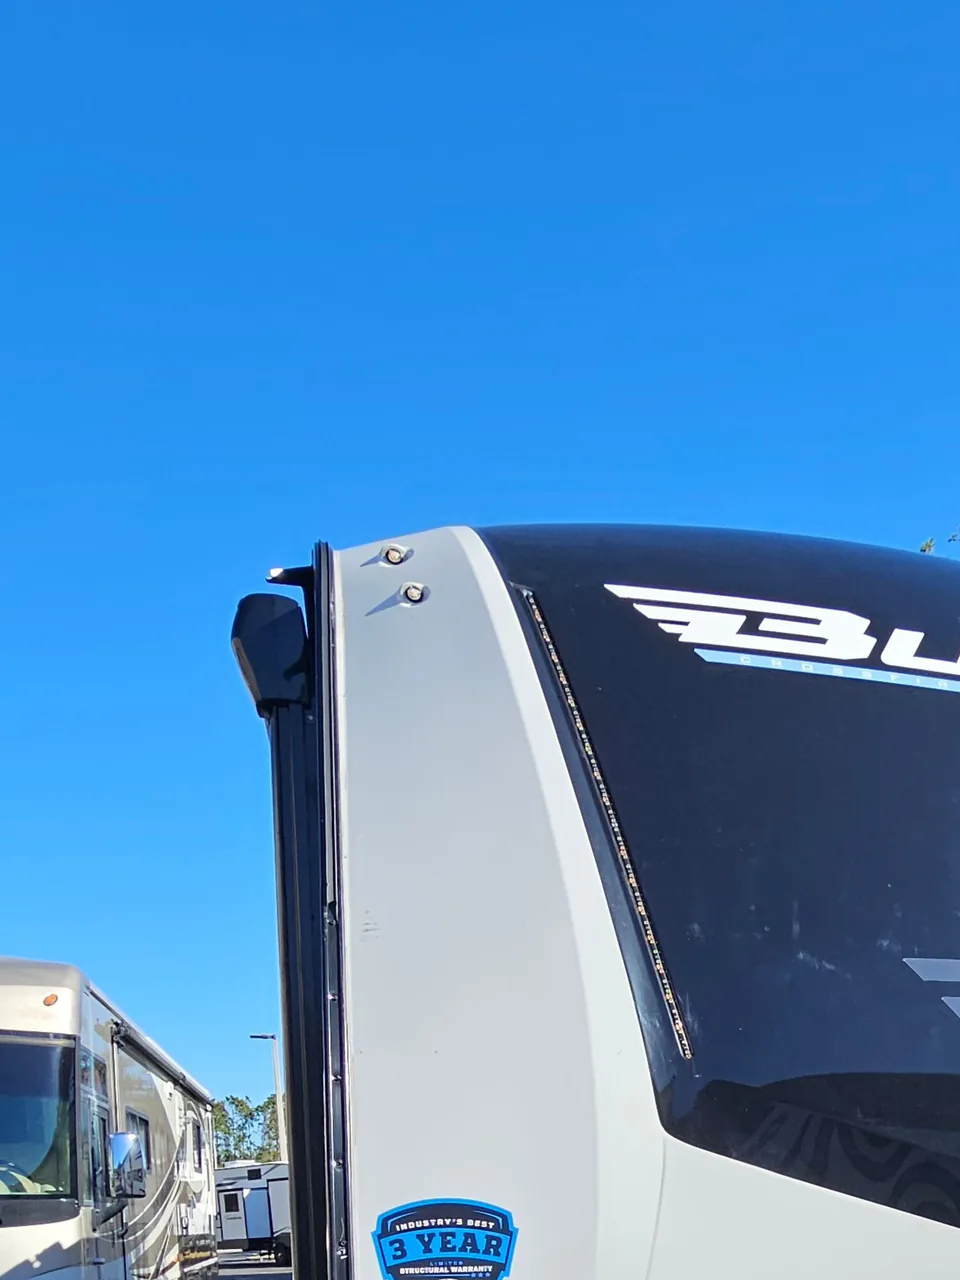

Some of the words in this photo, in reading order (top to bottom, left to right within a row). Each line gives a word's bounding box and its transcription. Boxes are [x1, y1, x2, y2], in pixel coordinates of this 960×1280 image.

[395, 1218, 463, 1231] INDUSTRY'S
[467, 1219, 495, 1229] BEST
[388, 1238, 408, 1260] 3
[416, 1231, 503, 1257] YEAR
[399, 1266, 449, 1275] STRUCTURAL
[450, 1265, 493, 1273] WARRANTY
